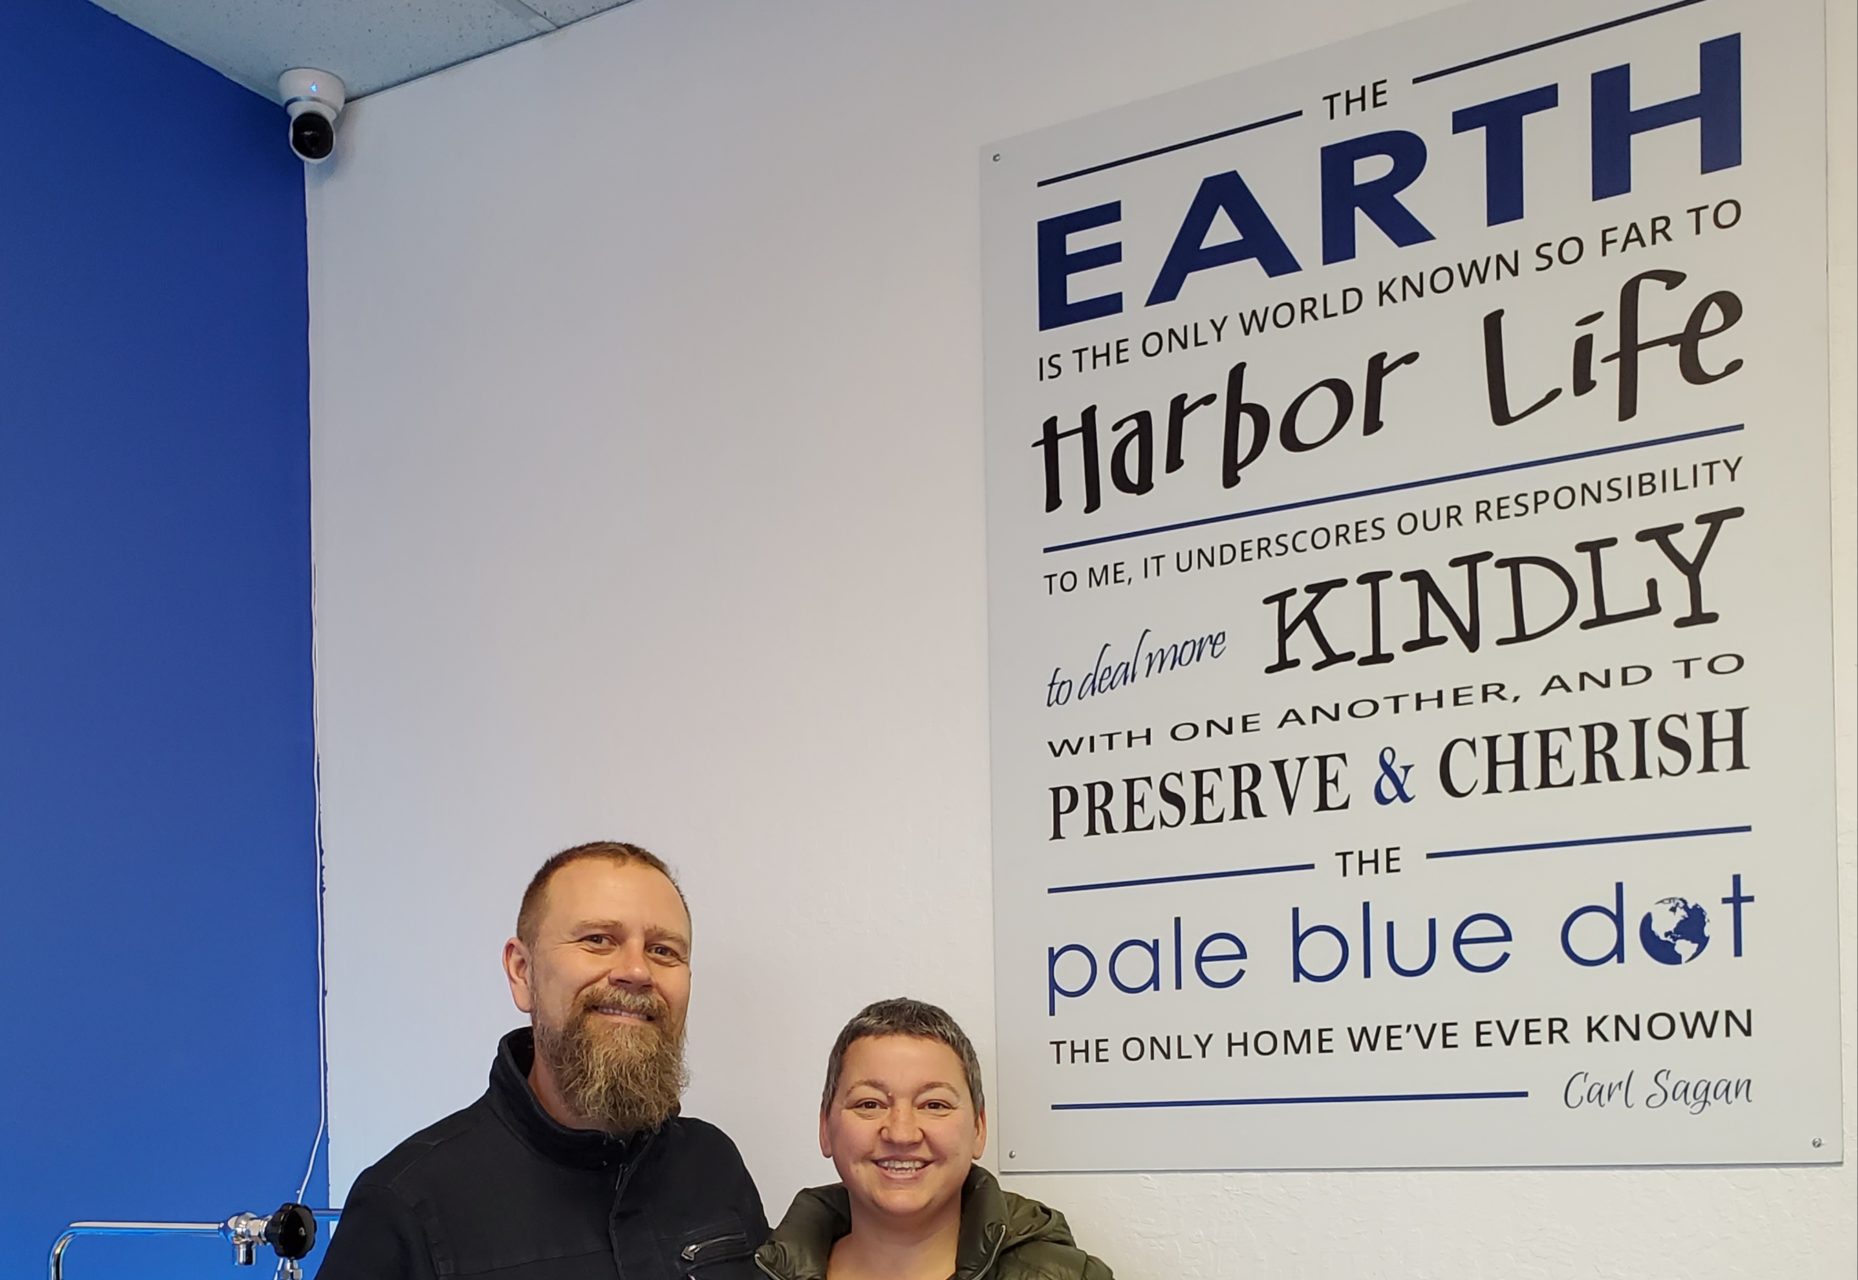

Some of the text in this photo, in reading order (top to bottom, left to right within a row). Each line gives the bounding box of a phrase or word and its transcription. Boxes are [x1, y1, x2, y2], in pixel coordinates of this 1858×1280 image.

[1321, 78, 1388, 120] THE
[1036, 31, 1743, 332] EARTH
[1038, 198, 1741, 381] IS THE ONLY WORLD KNOWN SO FAR TO
[1030, 268, 1743, 514] Harbor Life
[1042, 455, 1743, 595] TO ME, IT UNDERSCORES OUR RESPONSIBILITY
[1046, 505, 1746, 707] to deal more KINDLY
[1046, 652, 1744, 758] WITH ONE ANOTHER, AND TO
[1047, 705, 1750, 841] PRESERVE & CHERISH
[1334, 845, 1401, 877] THE
[1047, 915, 1248, 1016] pale
[1291, 900, 1513, 983] blue
[1048, 1037, 1109, 1064] THE
[1121, 1032, 1213, 1061] ONLY
[1226, 1026, 1334, 1057] HOME
[1474, 1016, 1570, 1047] EVER
[1586, 1008, 1752, 1043] KNOWN
[1563, 1068, 1752, 1115] Carl Sagan
